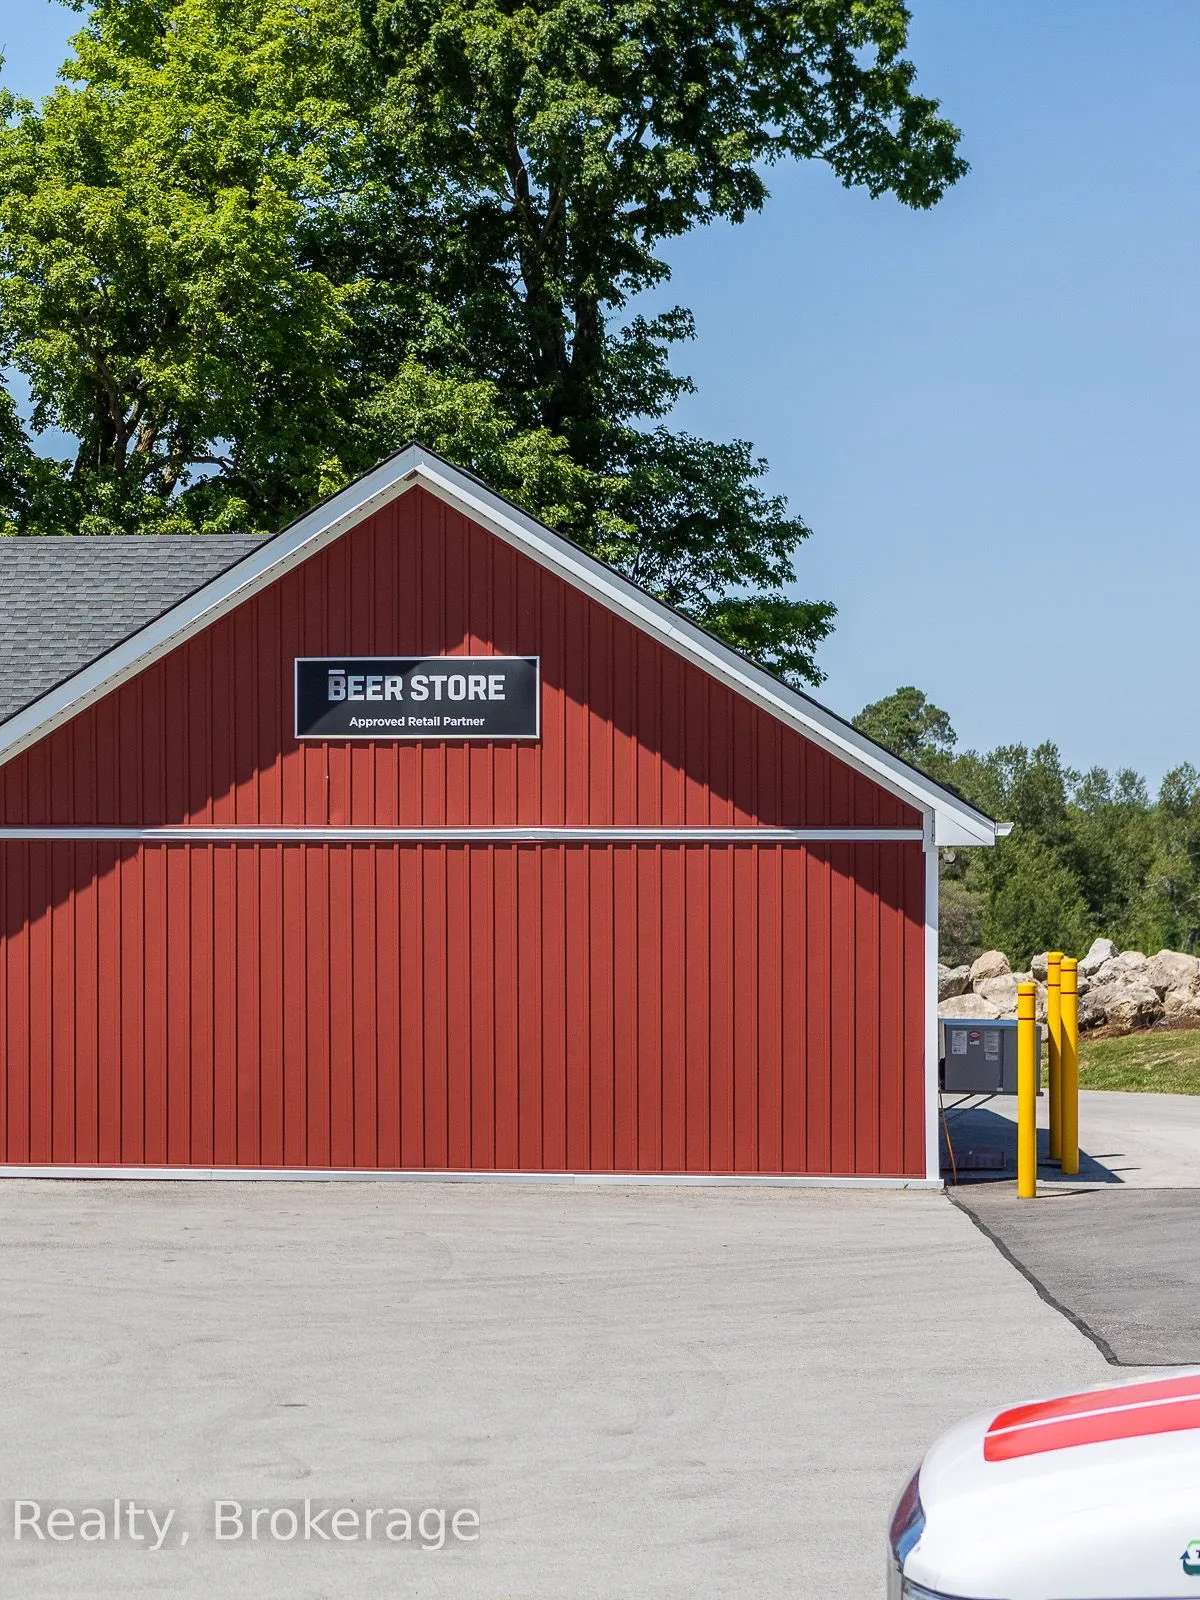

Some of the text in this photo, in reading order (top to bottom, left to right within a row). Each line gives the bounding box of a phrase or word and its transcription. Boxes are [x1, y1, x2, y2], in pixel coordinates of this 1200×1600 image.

[328, 669, 506, 701] BEER STORE
[349, 716, 485, 728] Approved Retail Partner
